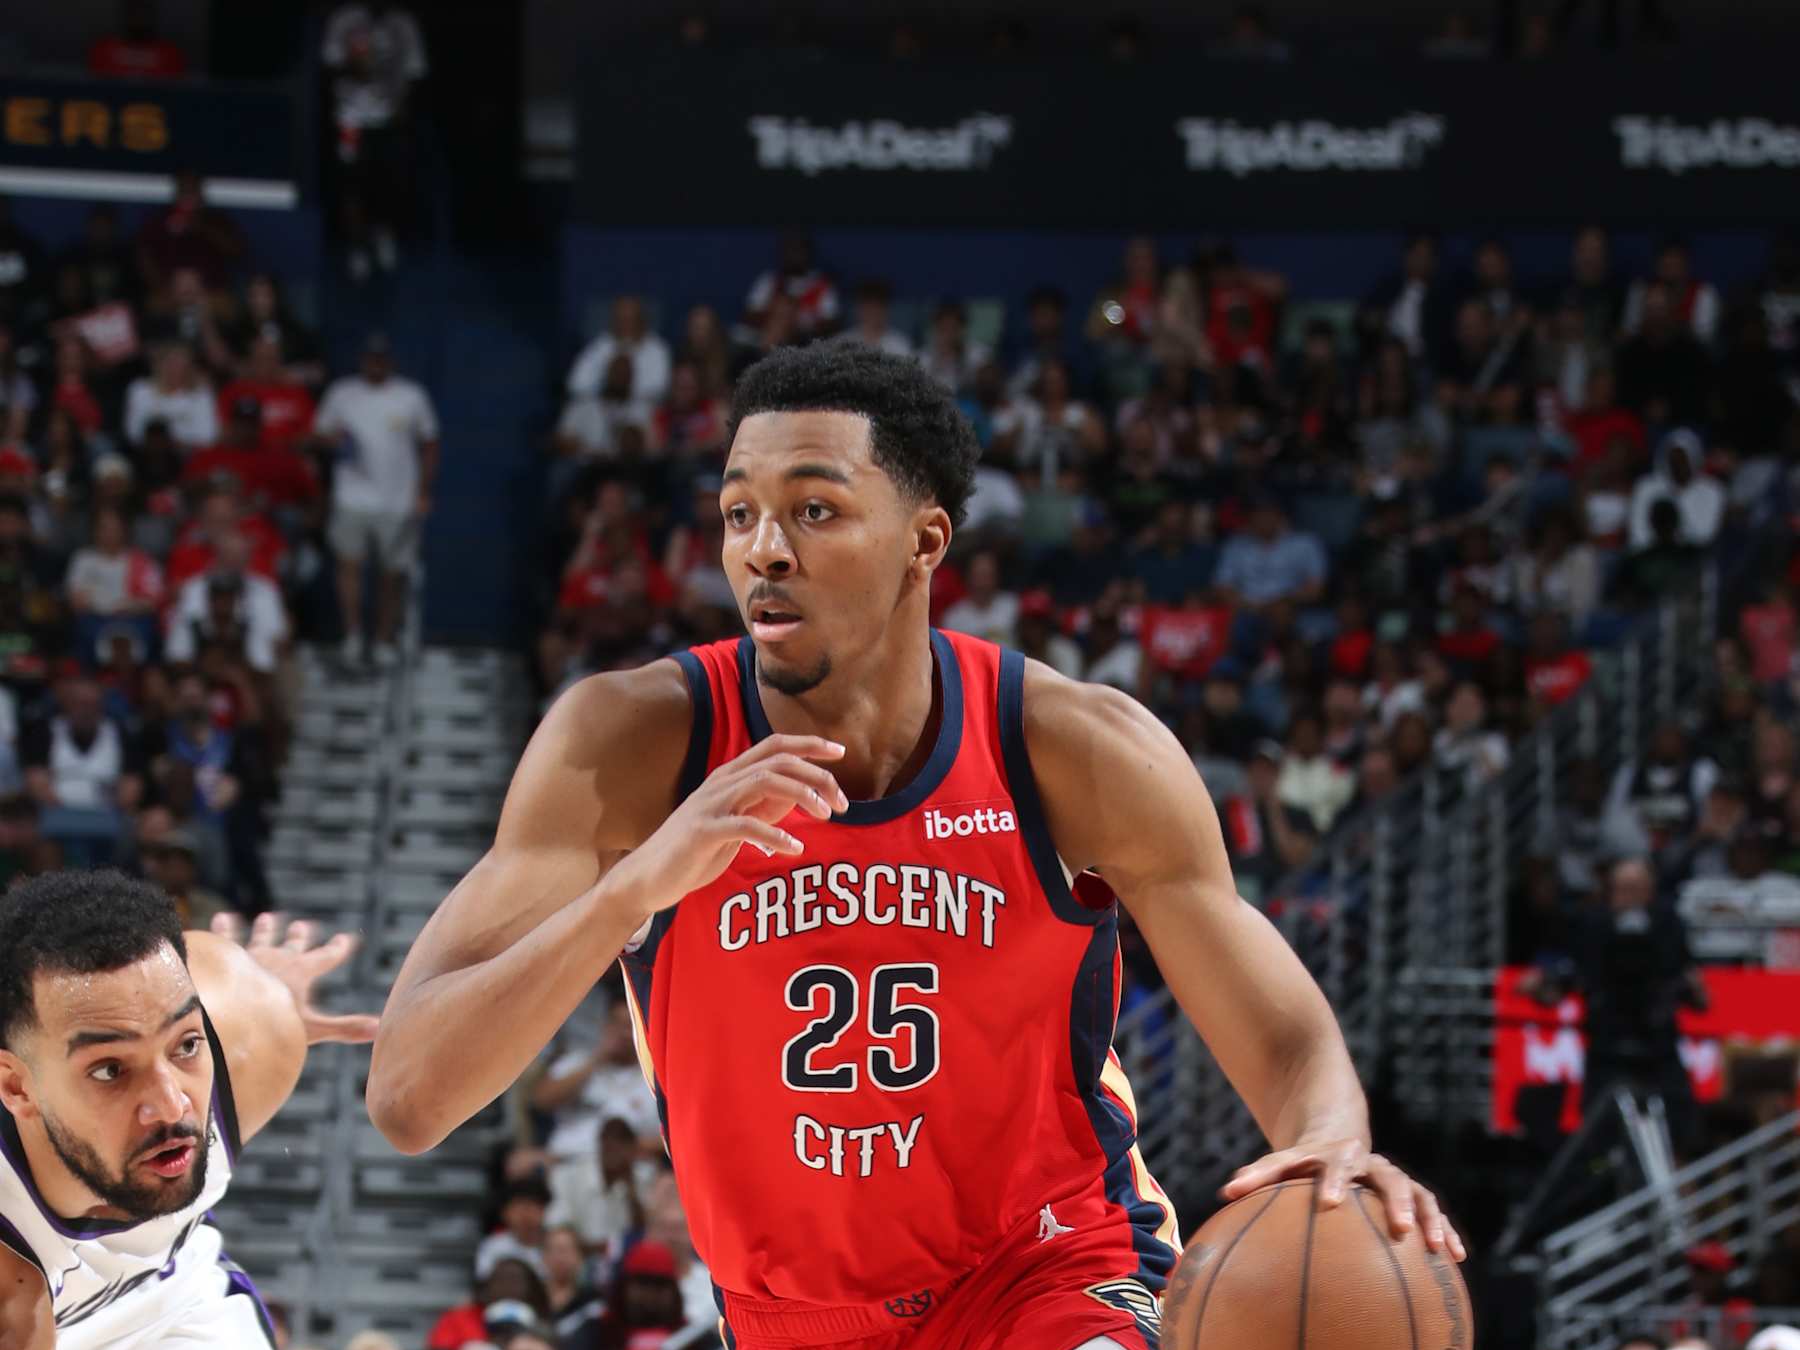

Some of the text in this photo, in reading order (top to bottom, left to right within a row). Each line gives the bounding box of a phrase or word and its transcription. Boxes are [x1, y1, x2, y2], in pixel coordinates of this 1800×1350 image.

[923, 807, 1017, 840] ibotta
[717, 862, 1006, 952] CRESCENT
[781, 961, 941, 1093] 25
[793, 1112, 925, 1178] CITY
